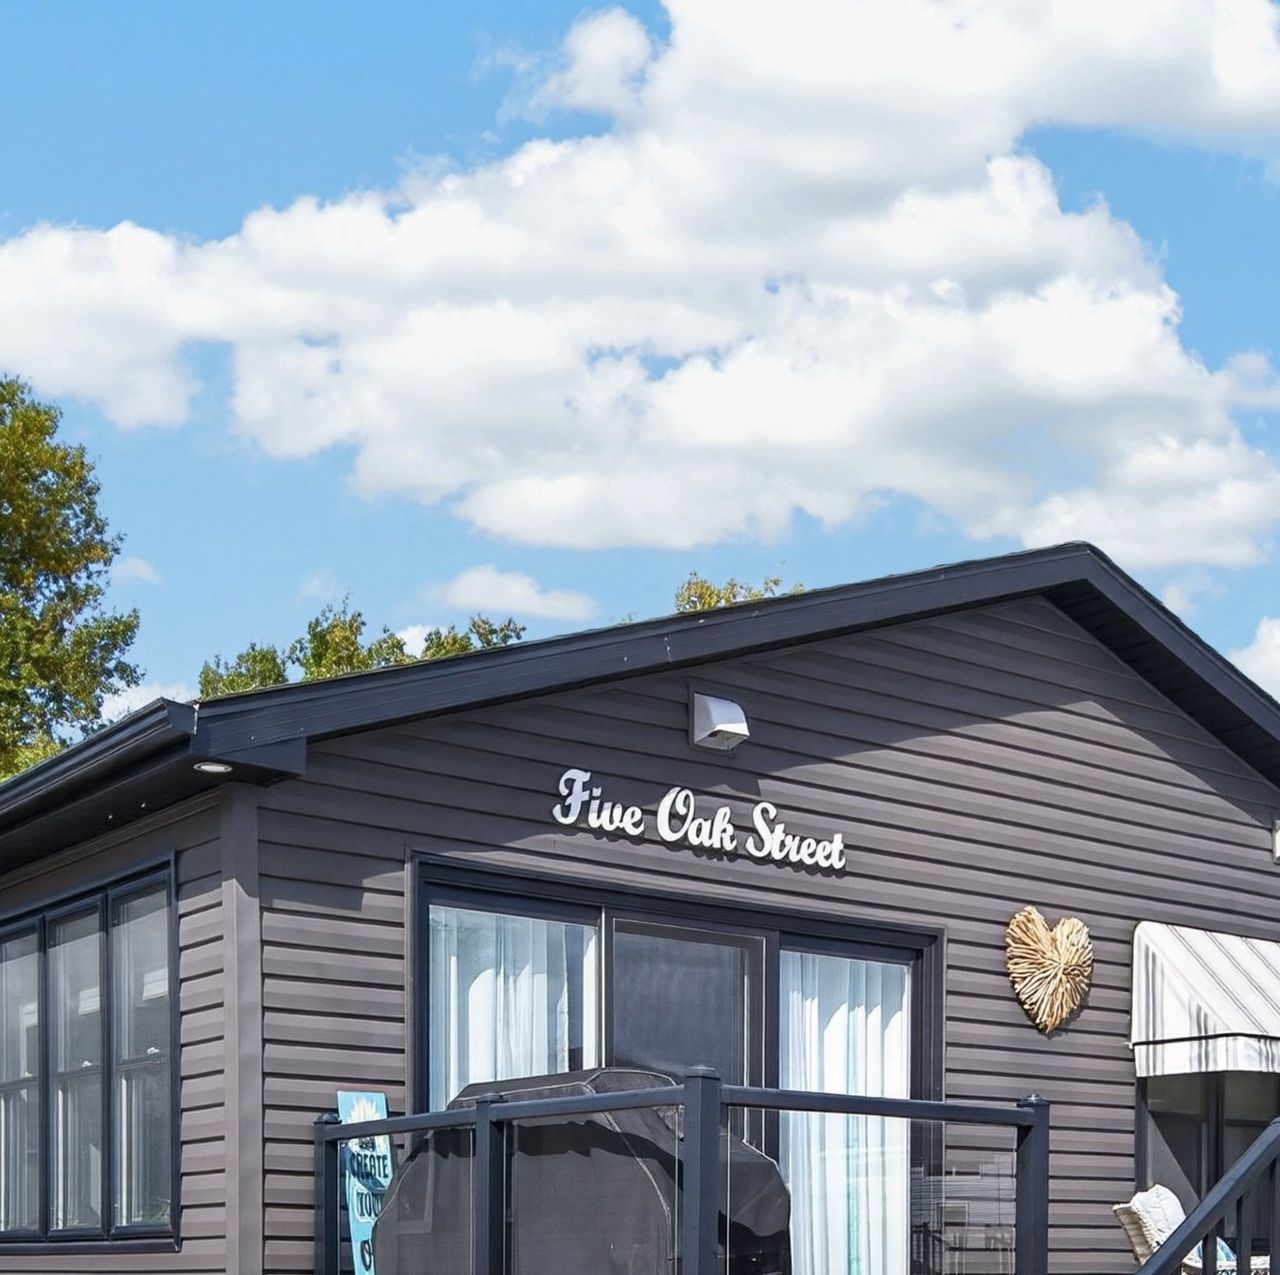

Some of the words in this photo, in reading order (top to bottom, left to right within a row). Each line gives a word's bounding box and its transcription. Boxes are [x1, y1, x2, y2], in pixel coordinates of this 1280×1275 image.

[552, 768, 645, 836] Five
[656, 786, 737, 852] Oak
[745, 801, 846, 870] Street
[350, 1153, 389, 1179] CREATE
